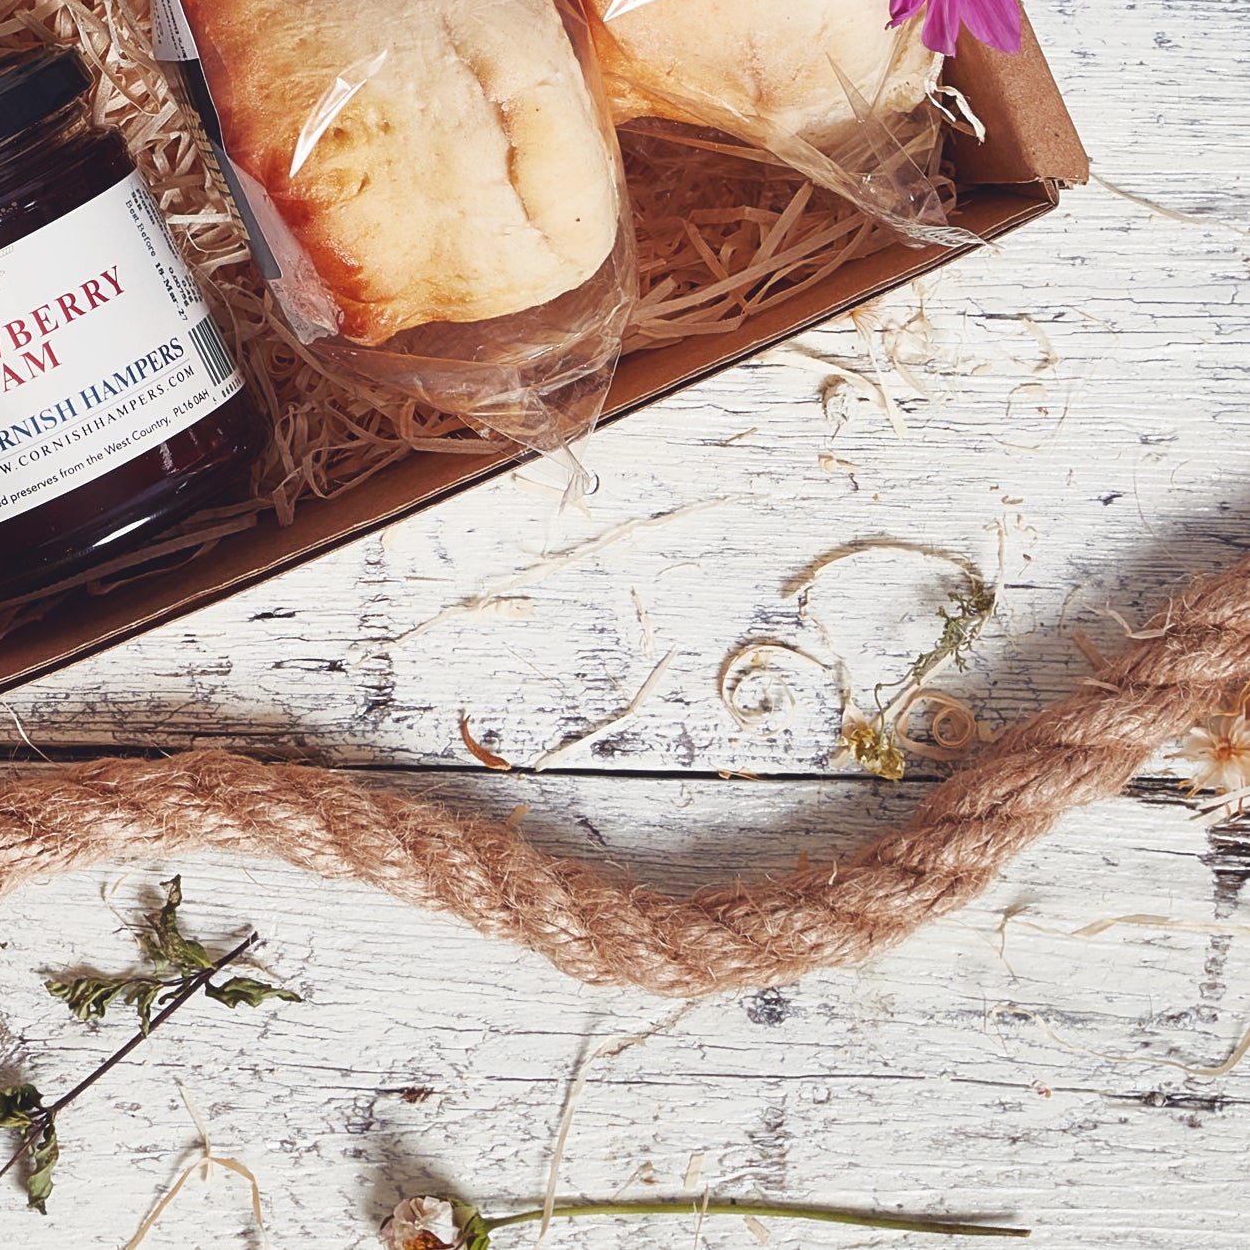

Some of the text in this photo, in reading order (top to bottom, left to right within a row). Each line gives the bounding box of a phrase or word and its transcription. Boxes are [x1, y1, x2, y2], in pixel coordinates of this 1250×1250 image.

[126, 199, 141, 225] Best
[137, 222, 156, 257] Before
[130, 191, 143, 211] Salt
[135, 188, 156, 225] Protein
[77, 336, 186, 412] HAMPERS
[9, 473, 60, 505] preserves
[58, 461, 85, 479] from
[86, 451, 105, 468] the
[103, 436, 132, 457] West
[131, 414, 173, 445] Country,
[172, 401, 196, 419] PL16
[192, 388, 211, 409] 0AH
